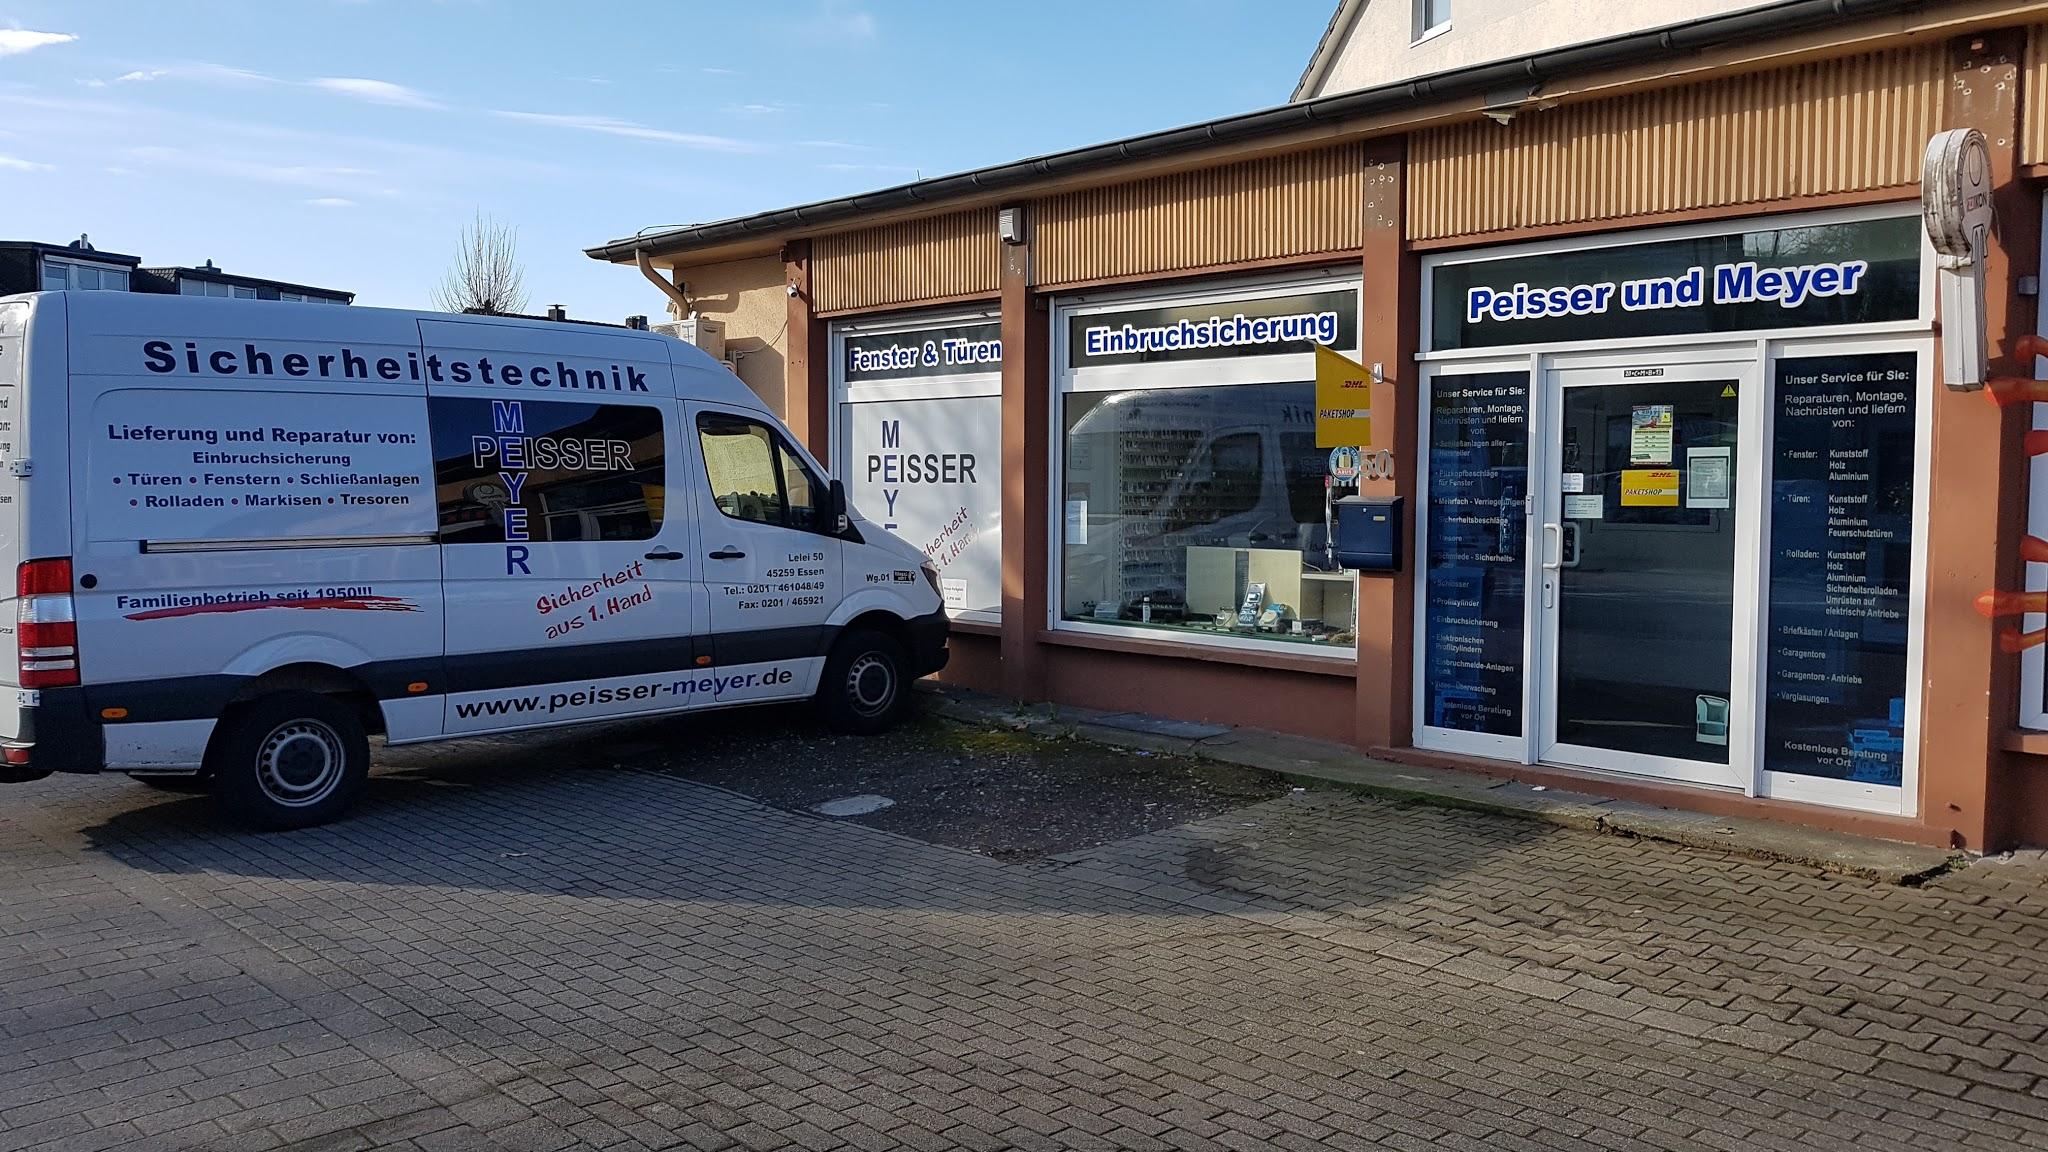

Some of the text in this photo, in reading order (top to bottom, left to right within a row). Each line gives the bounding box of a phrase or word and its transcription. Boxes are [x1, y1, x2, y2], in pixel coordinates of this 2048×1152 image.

[1469, 261, 1865, 321] Peisser und Meyer
[1087, 314, 1336, 351] Einbruchsicherung
[851, 341, 1001, 370] Fenster & Türen
[143, 340, 649, 392] Sicherheitstechnik
[1785, 370, 1909, 385] Unser Service für Sie:
[1436, 387, 1525, 398] Unser Service für Sie:
[1785, 391, 1907, 405] Reparaturen, Montage,
[1319, 408, 1355, 419] PAKETSHOP
[1436, 404, 1524, 416] Reparaturen, Montage,
[1785, 404, 1906, 416] Nachrüsten und liefern
[1437, 415, 1523, 425] Nachrüsten und liefern
[1832, 418, 1855, 428] von:
[108, 424, 417, 446] Lieferung und Reparatur von:
[1470, 427, 1487, 435] von:
[193, 451, 351, 467] Einbruchsicherung
[472, 435, 635, 471] PEISSER
[1788, 449, 1869, 459] Fenster: Kunststoff
[868, 454, 977, 483] PEISSER
[1829, 461, 1846, 470] Holz
[128, 472, 420, 487] Türen Fenstern Schließanlagen
[881, 420, 900, 530] MEY
[1829, 472, 1869, 481] Aluminium
[491, 400, 531, 575] MEYER
[1438, 479, 1474, 487] für Fenster
[1624, 488, 1662, 496] PAKETSHOP
[145, 493, 409, 508] Rolladen Markisen Tresoren
[1438, 497, 1469, 505] Mehrfach
[1788, 494, 1868, 504] Türen: Kunststoff
[1828, 506, 1845, 514] Holz
[1438, 516, 1509, 525] Sicherheitsbeschläge
[1828, 517, 1868, 526] Aluminium
[923, 506, 968, 556] herheit
[1828, 529, 1893, 538] Feuerschutztüren
[788, 552, 824, 563] Lelei 50
[1474, 553, 1515, 563] Sicherheits-
[1786, 549, 1866, 560] Rolladen: Kunststoff
[1826, 562, 1843, 570] Holz
[766, 567, 824, 579] 45259 Essen
[866, 573, 890, 584] Wg.01
[1826, 573, 1866, 583] Aluminium
[536, 560, 645, 615] Sicherheit
[723, 585, 745, 597] Tel.:
[747, 584, 769, 595] 0201
[778, 581, 824, 593] 461048/49
[1826, 584, 1898, 595] Sicherheitsrolladen
[117, 587, 373, 609] Familienbetrieb seit 1950!!!
[738, 600, 760, 611] Fax:
[761, 599, 783, 610] 0201
[792, 596, 824, 608] 465921
[1437, 598, 1480, 608] Profilzylinder
[1826, 595, 1876, 606] Umrüsten auf
[545, 585, 652, 640] aus 1. Hand
[1825, 607, 1899, 619] elektrische Antriebe
[1436, 616, 1498, 629] Einbruchsicherung
[1783, 626, 1823, 637] Briefkästen
[1828, 629, 1858, 640] Anlagen
[1436, 634, 1485, 645] Elektronischen
[1435, 643, 1482, 654] Profilzylindern
[1782, 648, 1826, 660] Garagentore
[1435, 658, 1514, 673] Einbruchmelde-Anlagen
[1781, 670, 1825, 682] Garagentore
[1831, 674, 1863, 684] Antriebe
[457, 667, 793, 719] www.peisser-meyer.de
[1781, 692, 1830, 704] Verglasungen
[1478, 704, 1512, 717] Beratung
[1474, 713, 1486, 721] Ort
[1784, 740, 1887, 762] Kostenlose Beratung
[1817, 756, 1851, 767] vor Ort
